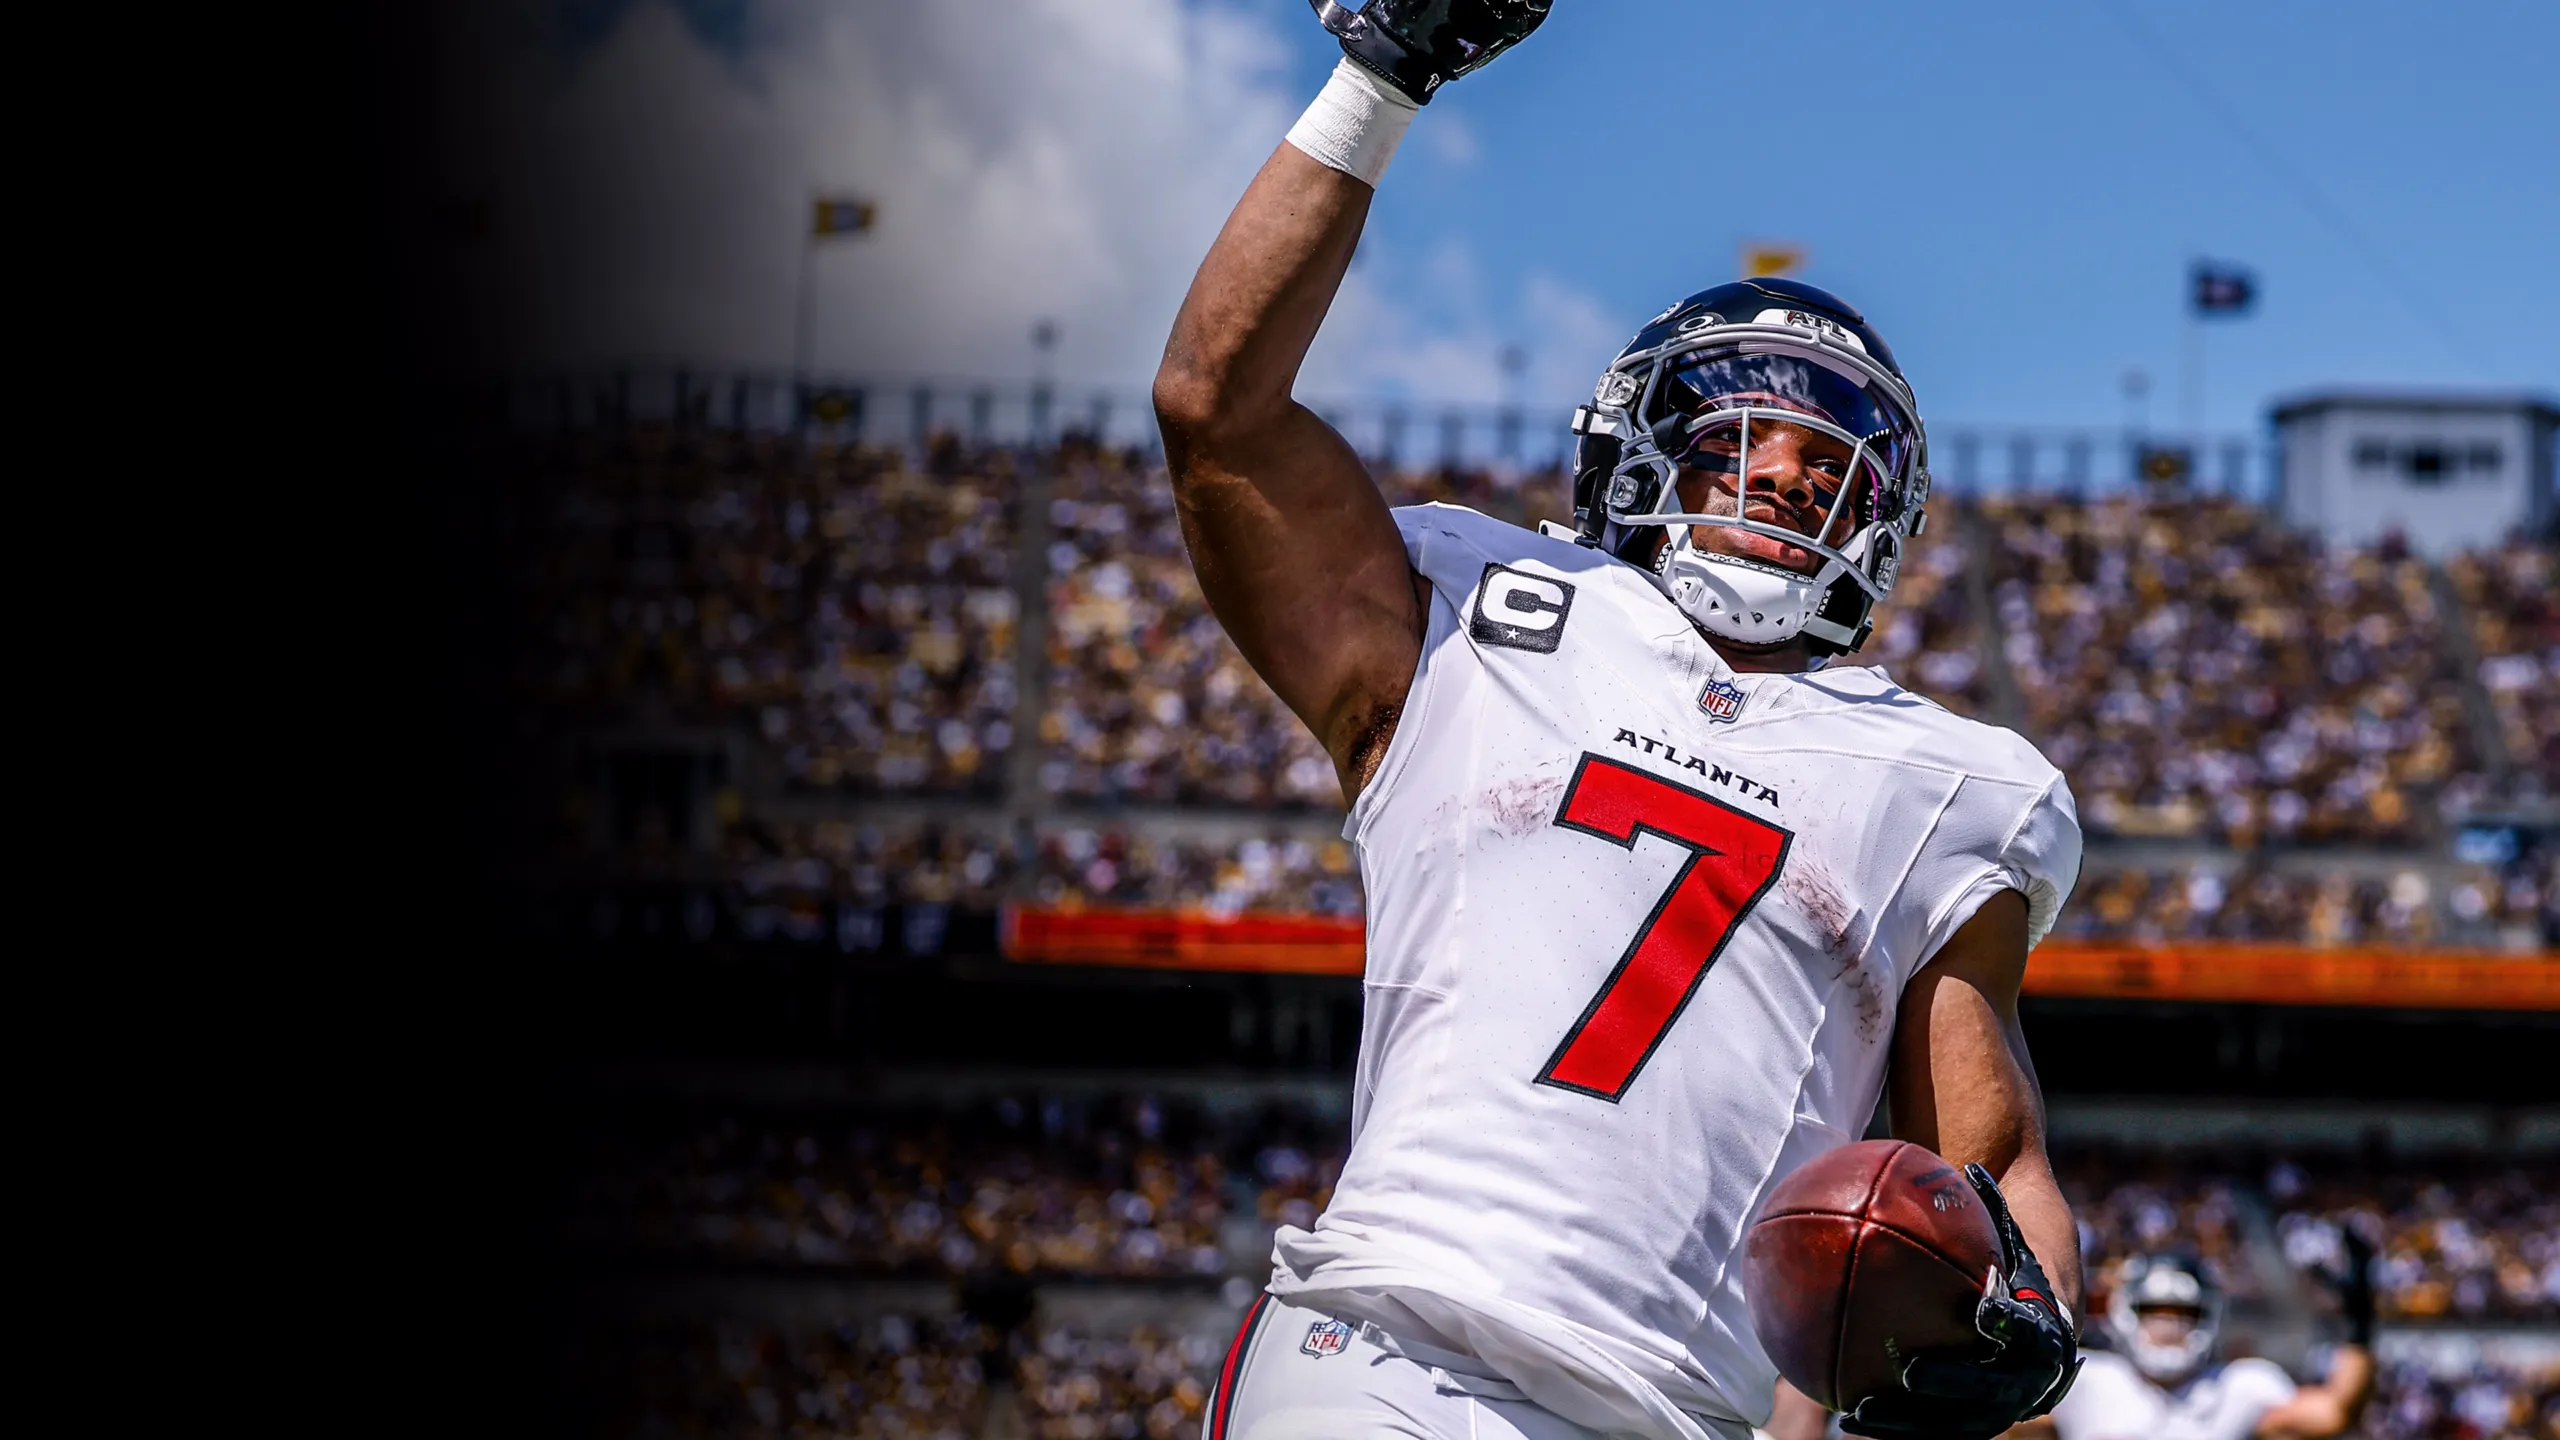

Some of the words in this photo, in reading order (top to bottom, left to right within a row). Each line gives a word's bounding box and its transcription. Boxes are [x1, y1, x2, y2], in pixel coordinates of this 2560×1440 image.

[1784, 309, 1848, 343] ATL
[1481, 571, 1564, 631] C
[1702, 691, 1733, 716] NFL
[1613, 727, 1780, 808] ATLANTA
[1533, 750, 1795, 1104] 7
[1308, 1334, 1340, 1350] NFL
